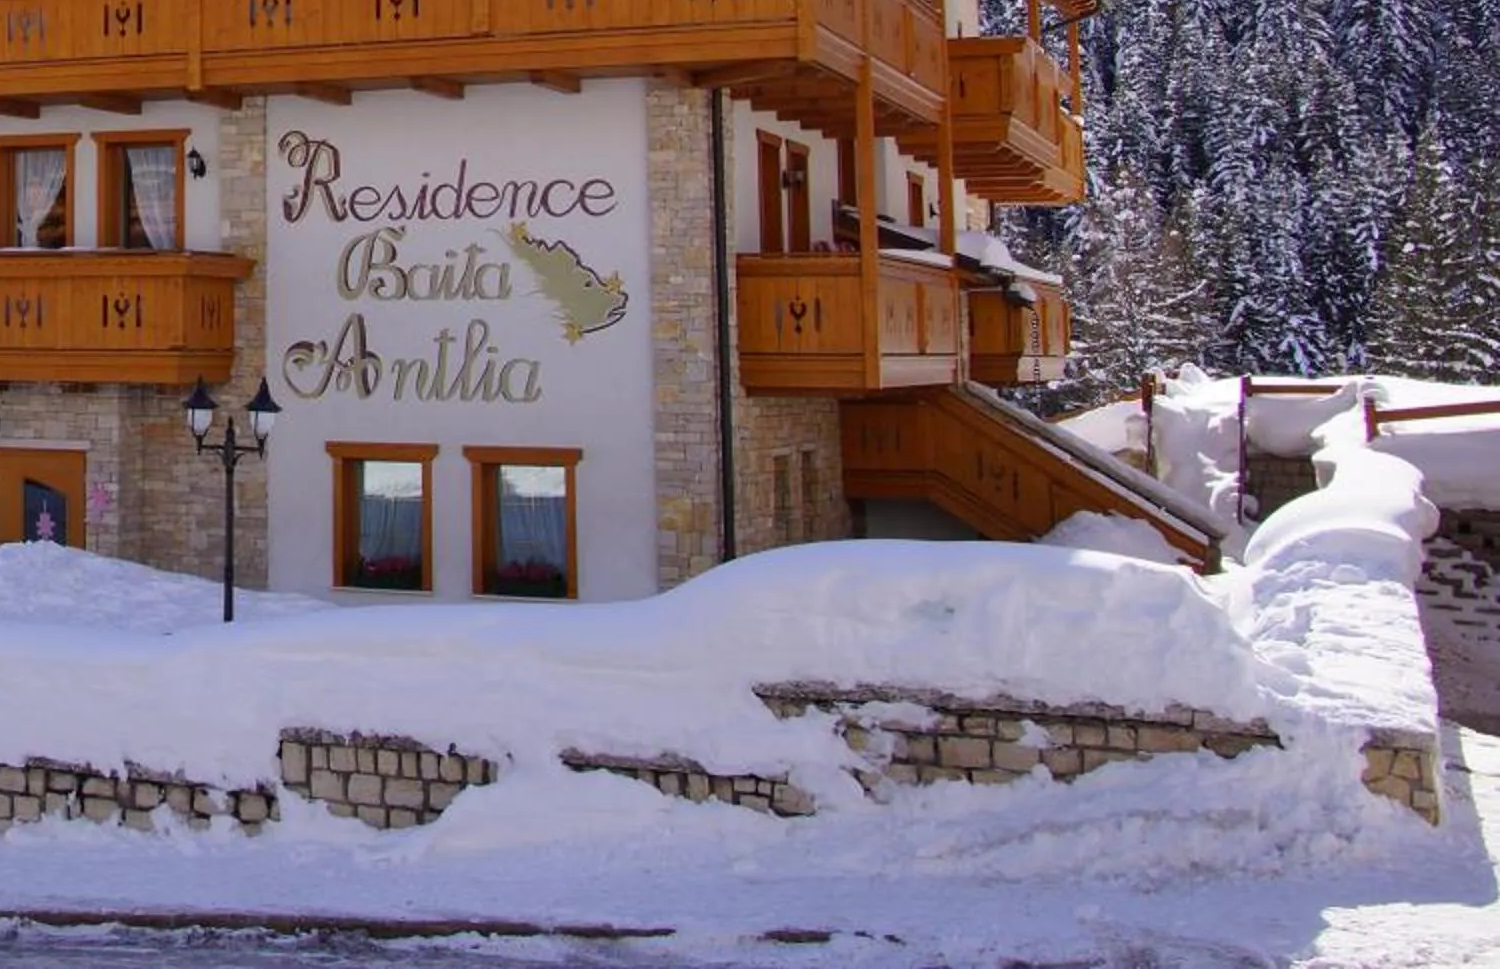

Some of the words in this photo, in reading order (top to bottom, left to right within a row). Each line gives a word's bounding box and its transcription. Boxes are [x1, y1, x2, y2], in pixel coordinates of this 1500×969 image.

[278, 130, 617, 223] Residence
[337, 226, 513, 301] Baita
[282, 313, 543, 404] Antlia
